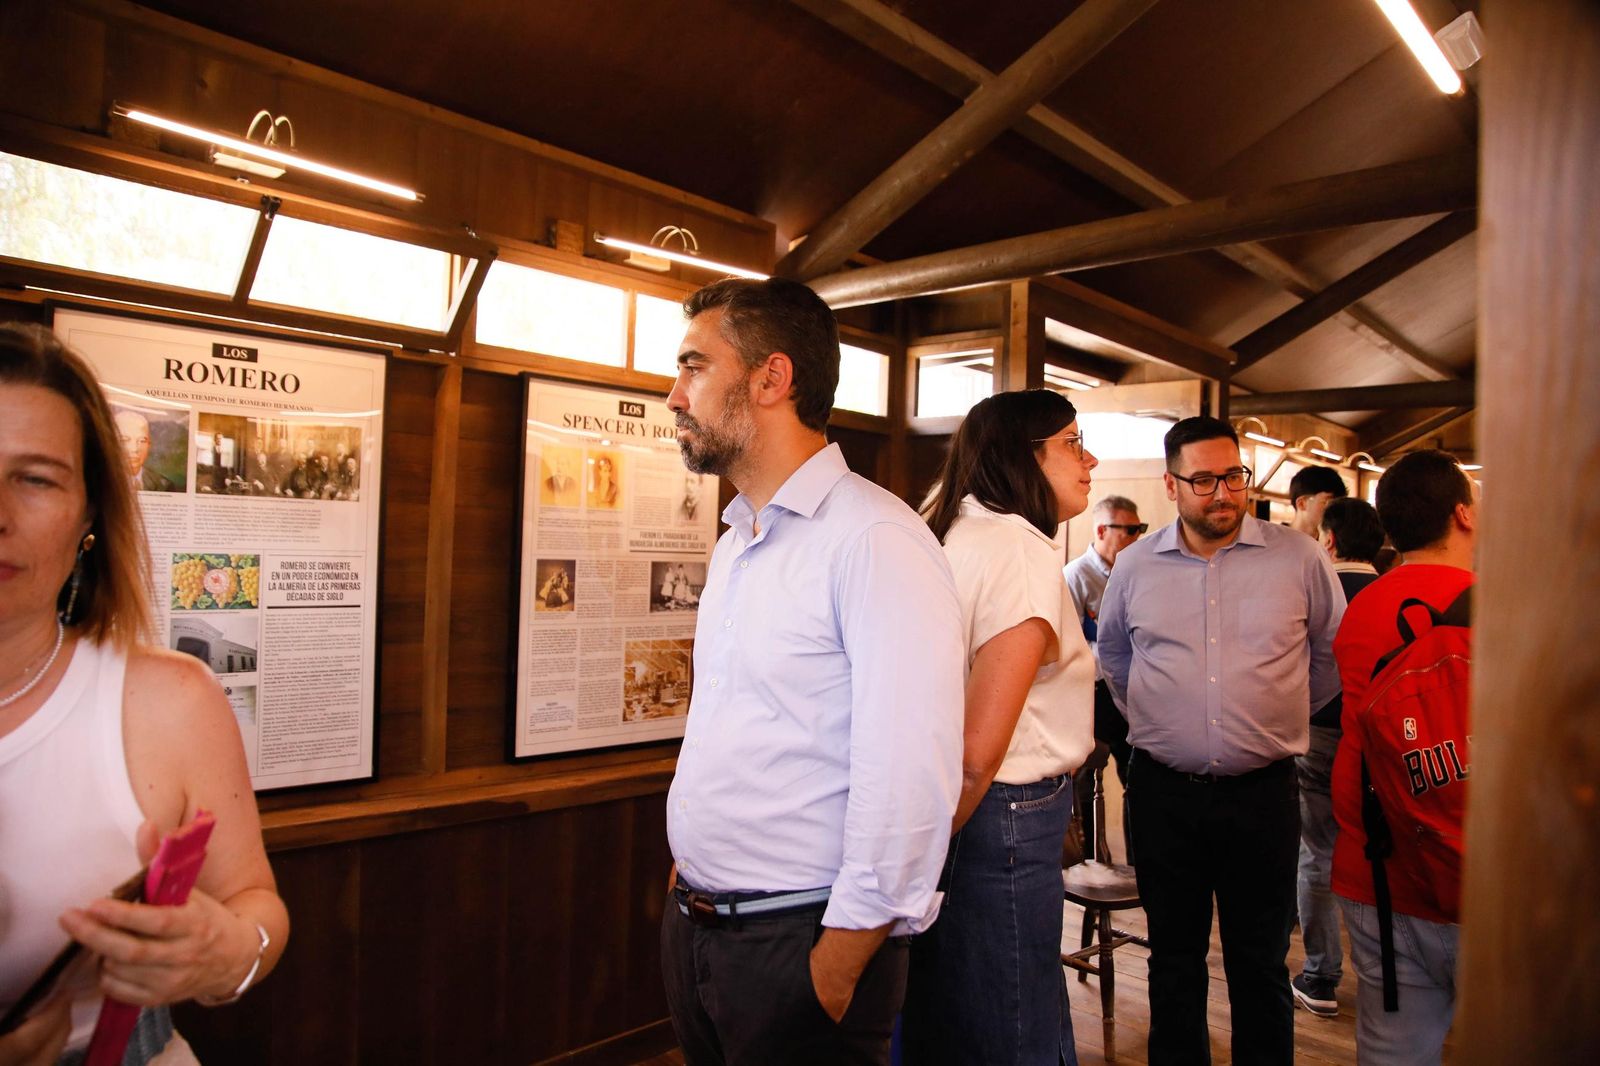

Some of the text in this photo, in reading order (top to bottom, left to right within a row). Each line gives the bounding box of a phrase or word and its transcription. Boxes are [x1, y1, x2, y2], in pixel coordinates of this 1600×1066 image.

[222, 346, 249, 360] LOS
[163, 357, 301, 394] ROMERO
[144, 389, 314, 413] AQUELLOS TIEMPOS DE ROMERO HERMANOS
[622, 403, 642, 416] LOS
[562, 412, 678, 440] SPENCER Y RO
[280, 561, 351, 571] ROMERO SE CONVIERTE
[271, 571, 359, 580] EN UN PODER ECONÓMICO EN
[268, 581, 361, 591] LA ALMERÍA DE LAS PRIMERAS
[317, 592, 325, 601] DE
[326, 592, 344, 601] SIGLO
[1402, 737, 1471, 798] BUL
